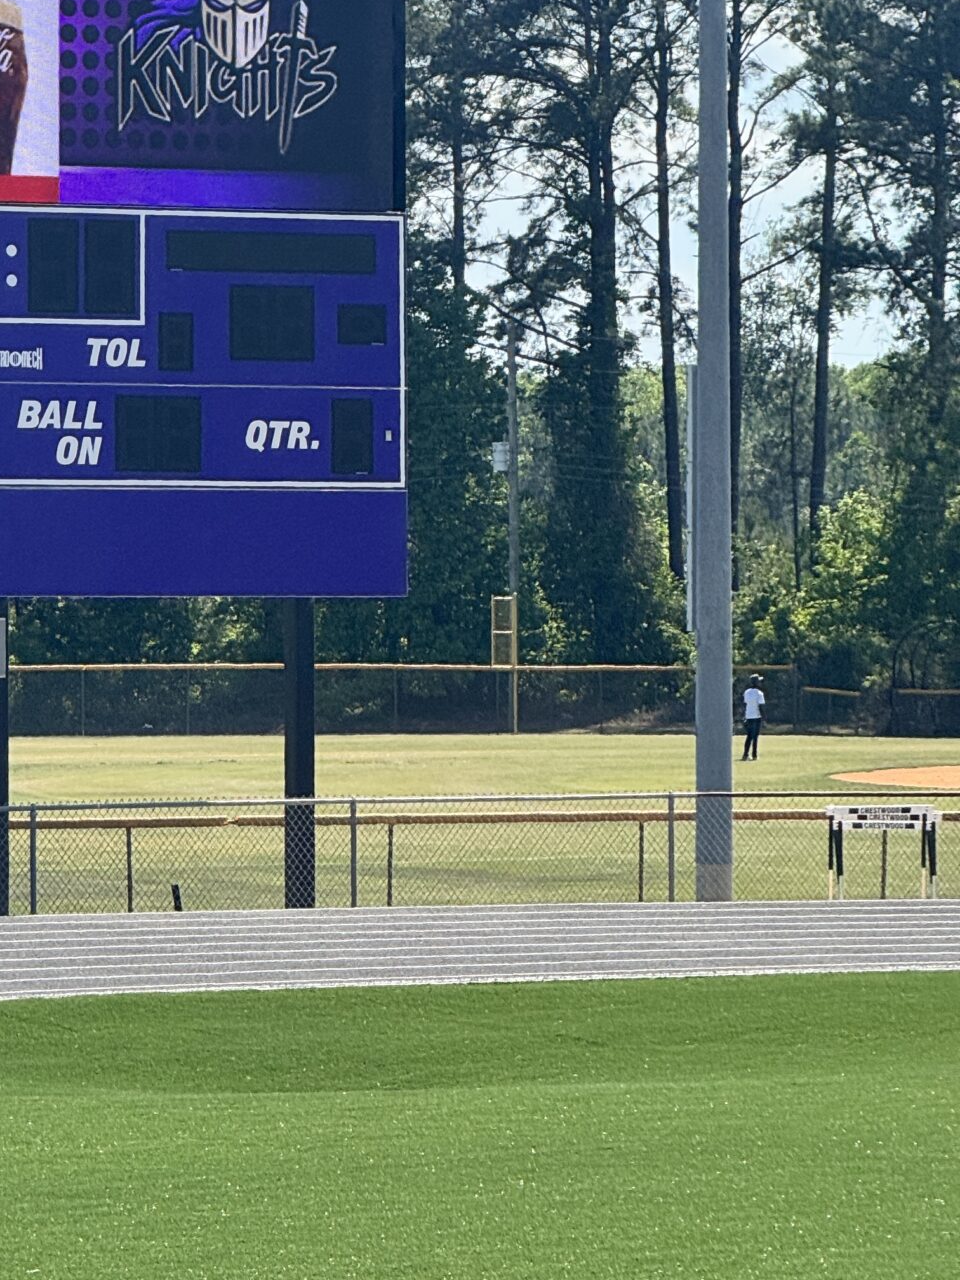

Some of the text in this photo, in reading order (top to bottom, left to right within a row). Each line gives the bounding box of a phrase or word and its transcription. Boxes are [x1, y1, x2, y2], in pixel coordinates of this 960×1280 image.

[86, 337, 147, 368] TOL
[16, 400, 104, 431] BALL
[55, 436, 103, 466] ON
[244, 420, 321, 453] QTR.
